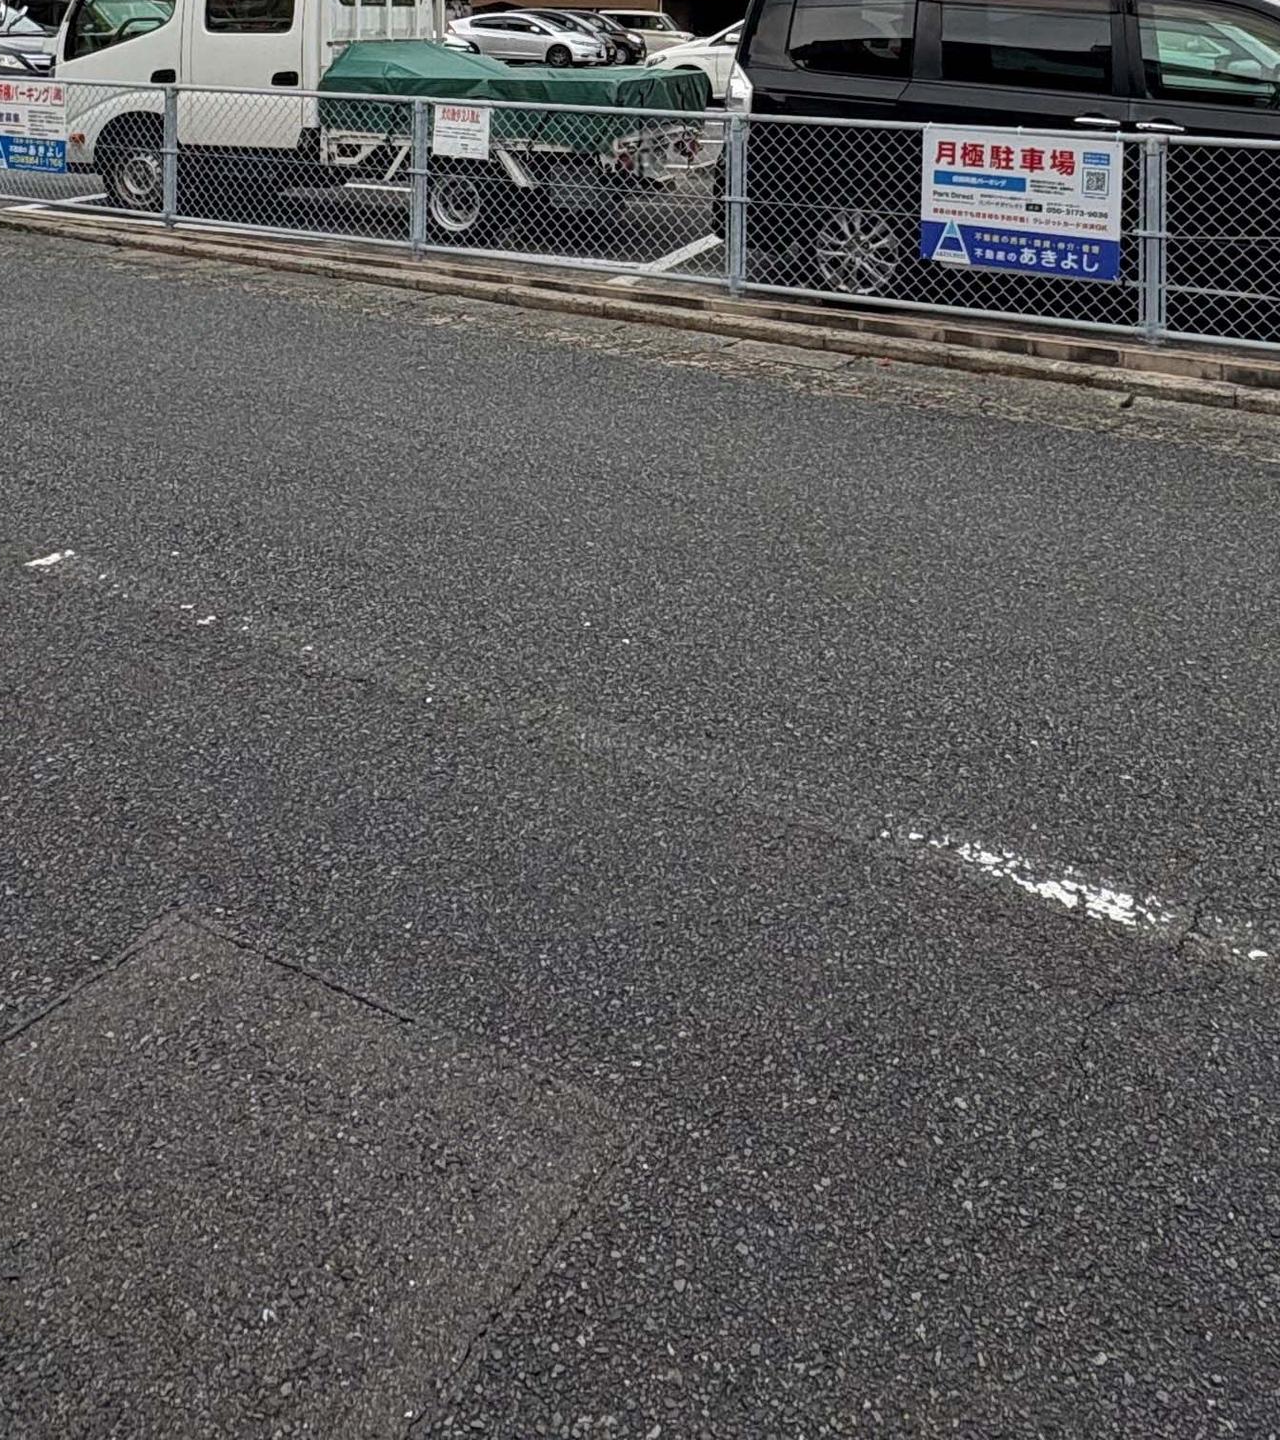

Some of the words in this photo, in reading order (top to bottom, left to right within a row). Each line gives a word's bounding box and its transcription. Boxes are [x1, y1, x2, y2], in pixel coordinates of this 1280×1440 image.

[935, 141, 1075, 176] 月極駐車場
